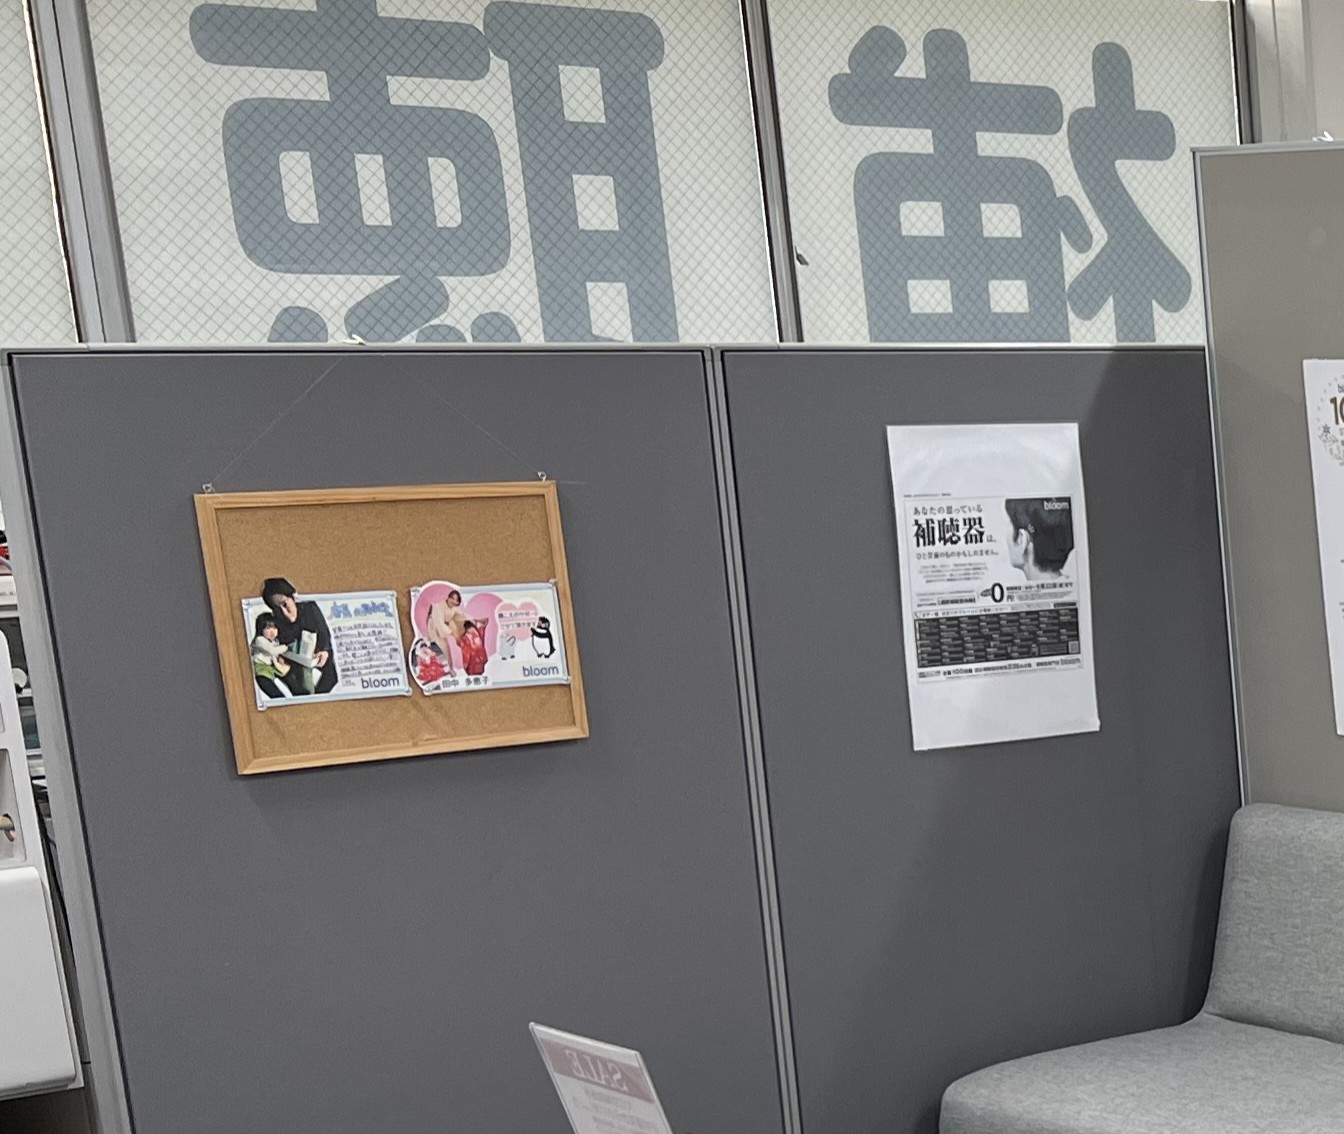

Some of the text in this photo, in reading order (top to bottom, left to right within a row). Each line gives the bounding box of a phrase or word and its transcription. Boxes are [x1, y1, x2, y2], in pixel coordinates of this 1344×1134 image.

[1044, 500, 1069, 510] bloom
[522, 665, 560, 677] bloom
[361, 677, 400, 689] bloom
